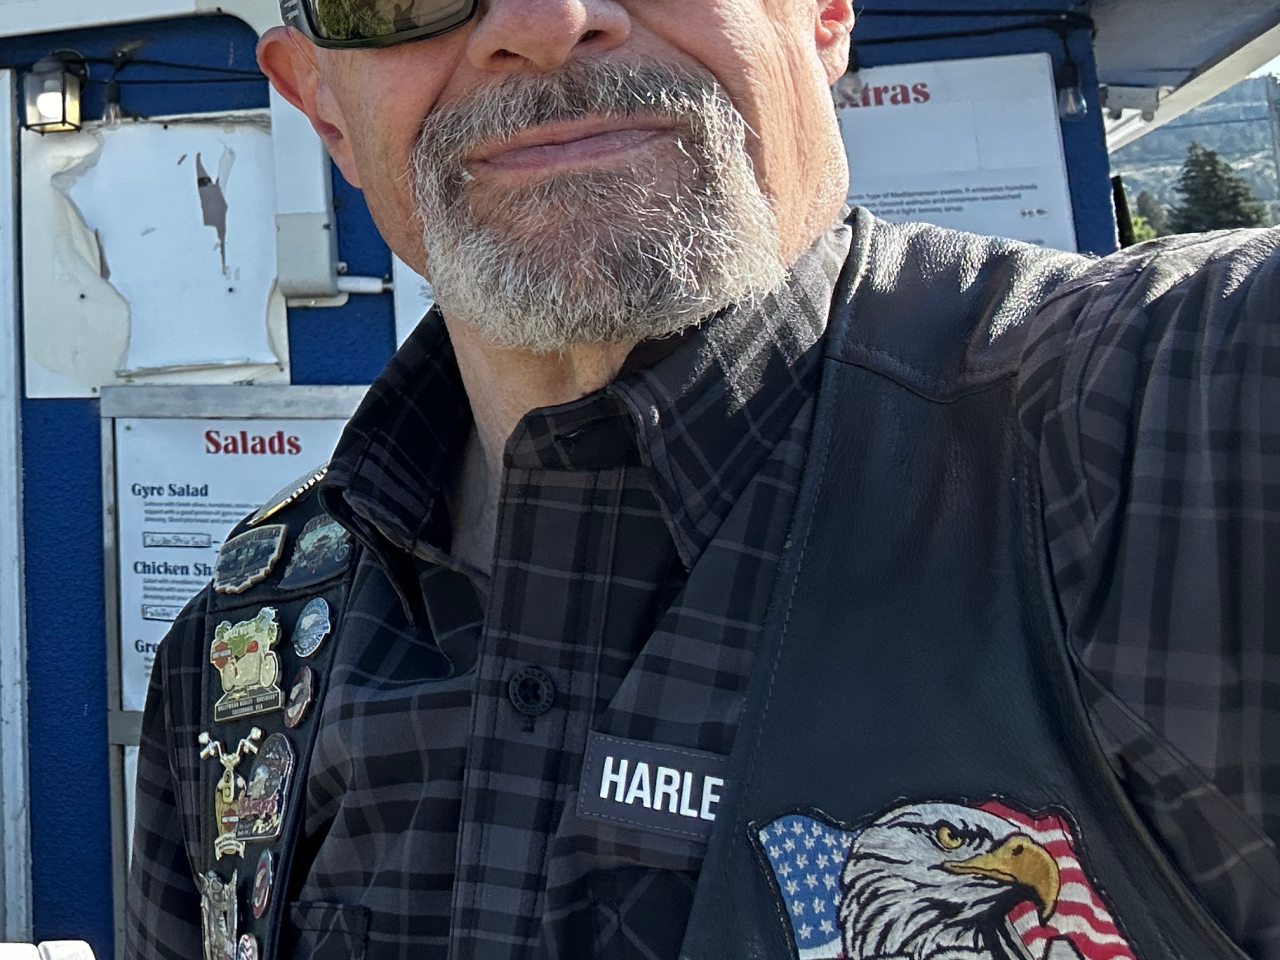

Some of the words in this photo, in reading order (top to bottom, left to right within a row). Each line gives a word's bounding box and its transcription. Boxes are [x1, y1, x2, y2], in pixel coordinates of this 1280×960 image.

[832, 82, 931, 109] xtras
[204, 429, 302, 455] Salads
[168, 483, 209, 497] Salad
[133, 560, 190, 576] Chicken
[193, 562, 215, 576] Sh
[599, 756, 724, 821] HARLE
